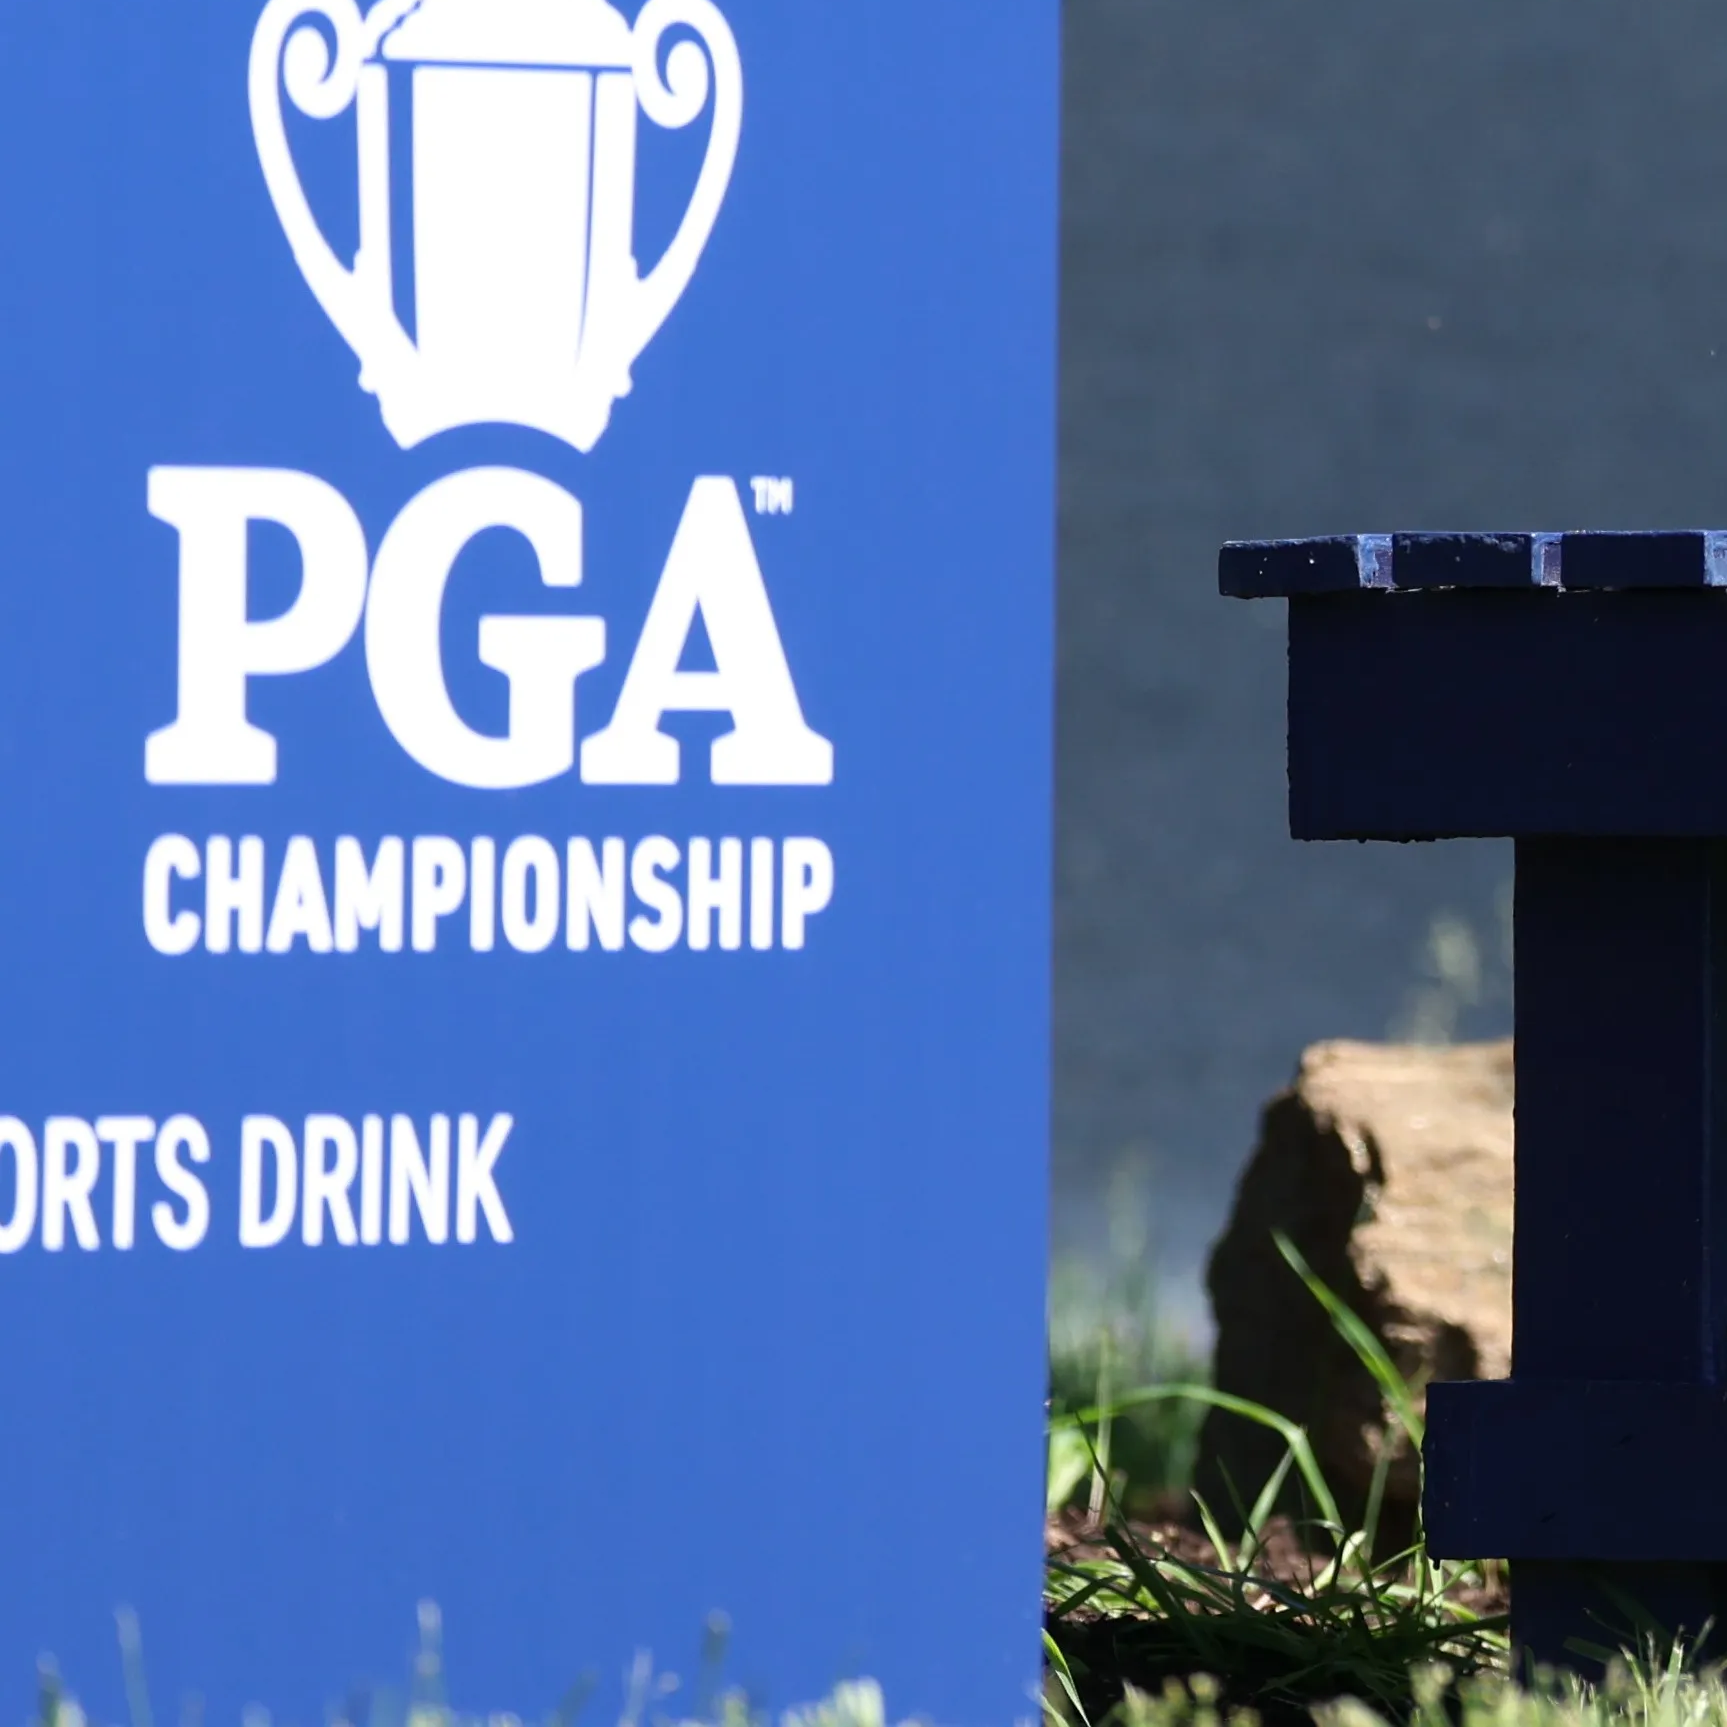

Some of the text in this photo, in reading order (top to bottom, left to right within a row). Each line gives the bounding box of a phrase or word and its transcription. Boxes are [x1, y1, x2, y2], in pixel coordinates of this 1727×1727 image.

[145, 465, 833, 789] PGA
[144, 833, 833, 955] CHAMPIONSHIP
[238, 1113, 514, 1248] DRINK
